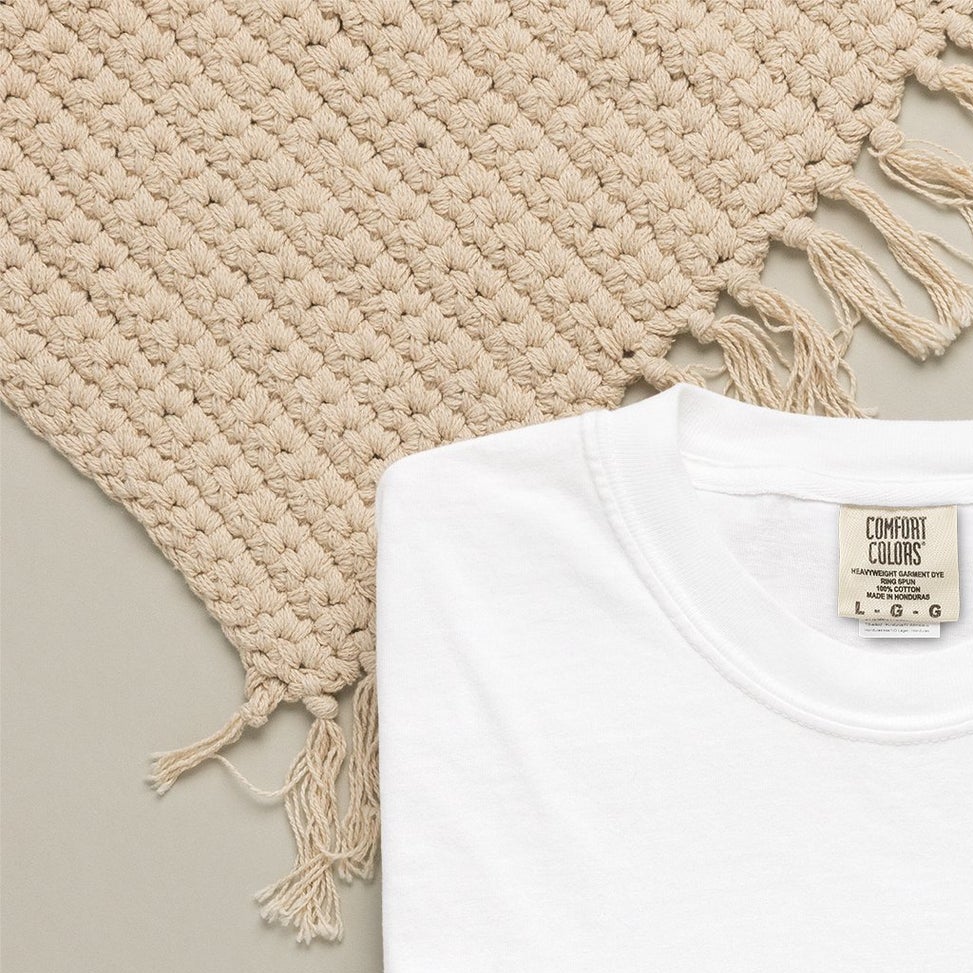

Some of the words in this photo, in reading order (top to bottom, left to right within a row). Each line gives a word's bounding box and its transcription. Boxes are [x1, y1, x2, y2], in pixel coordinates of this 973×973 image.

[866, 516, 927, 539] COMFORT
[851, 568, 898, 577] HEAVYWEIGHT
[898, 570, 930, 578] GARMENT
[866, 592, 885, 600] MADE
[894, 593, 930, 601] HONDURAS
[855, 601, 865, 615] L
[890, 604, 903, 617] G
[929, 604, 942, 618] G
